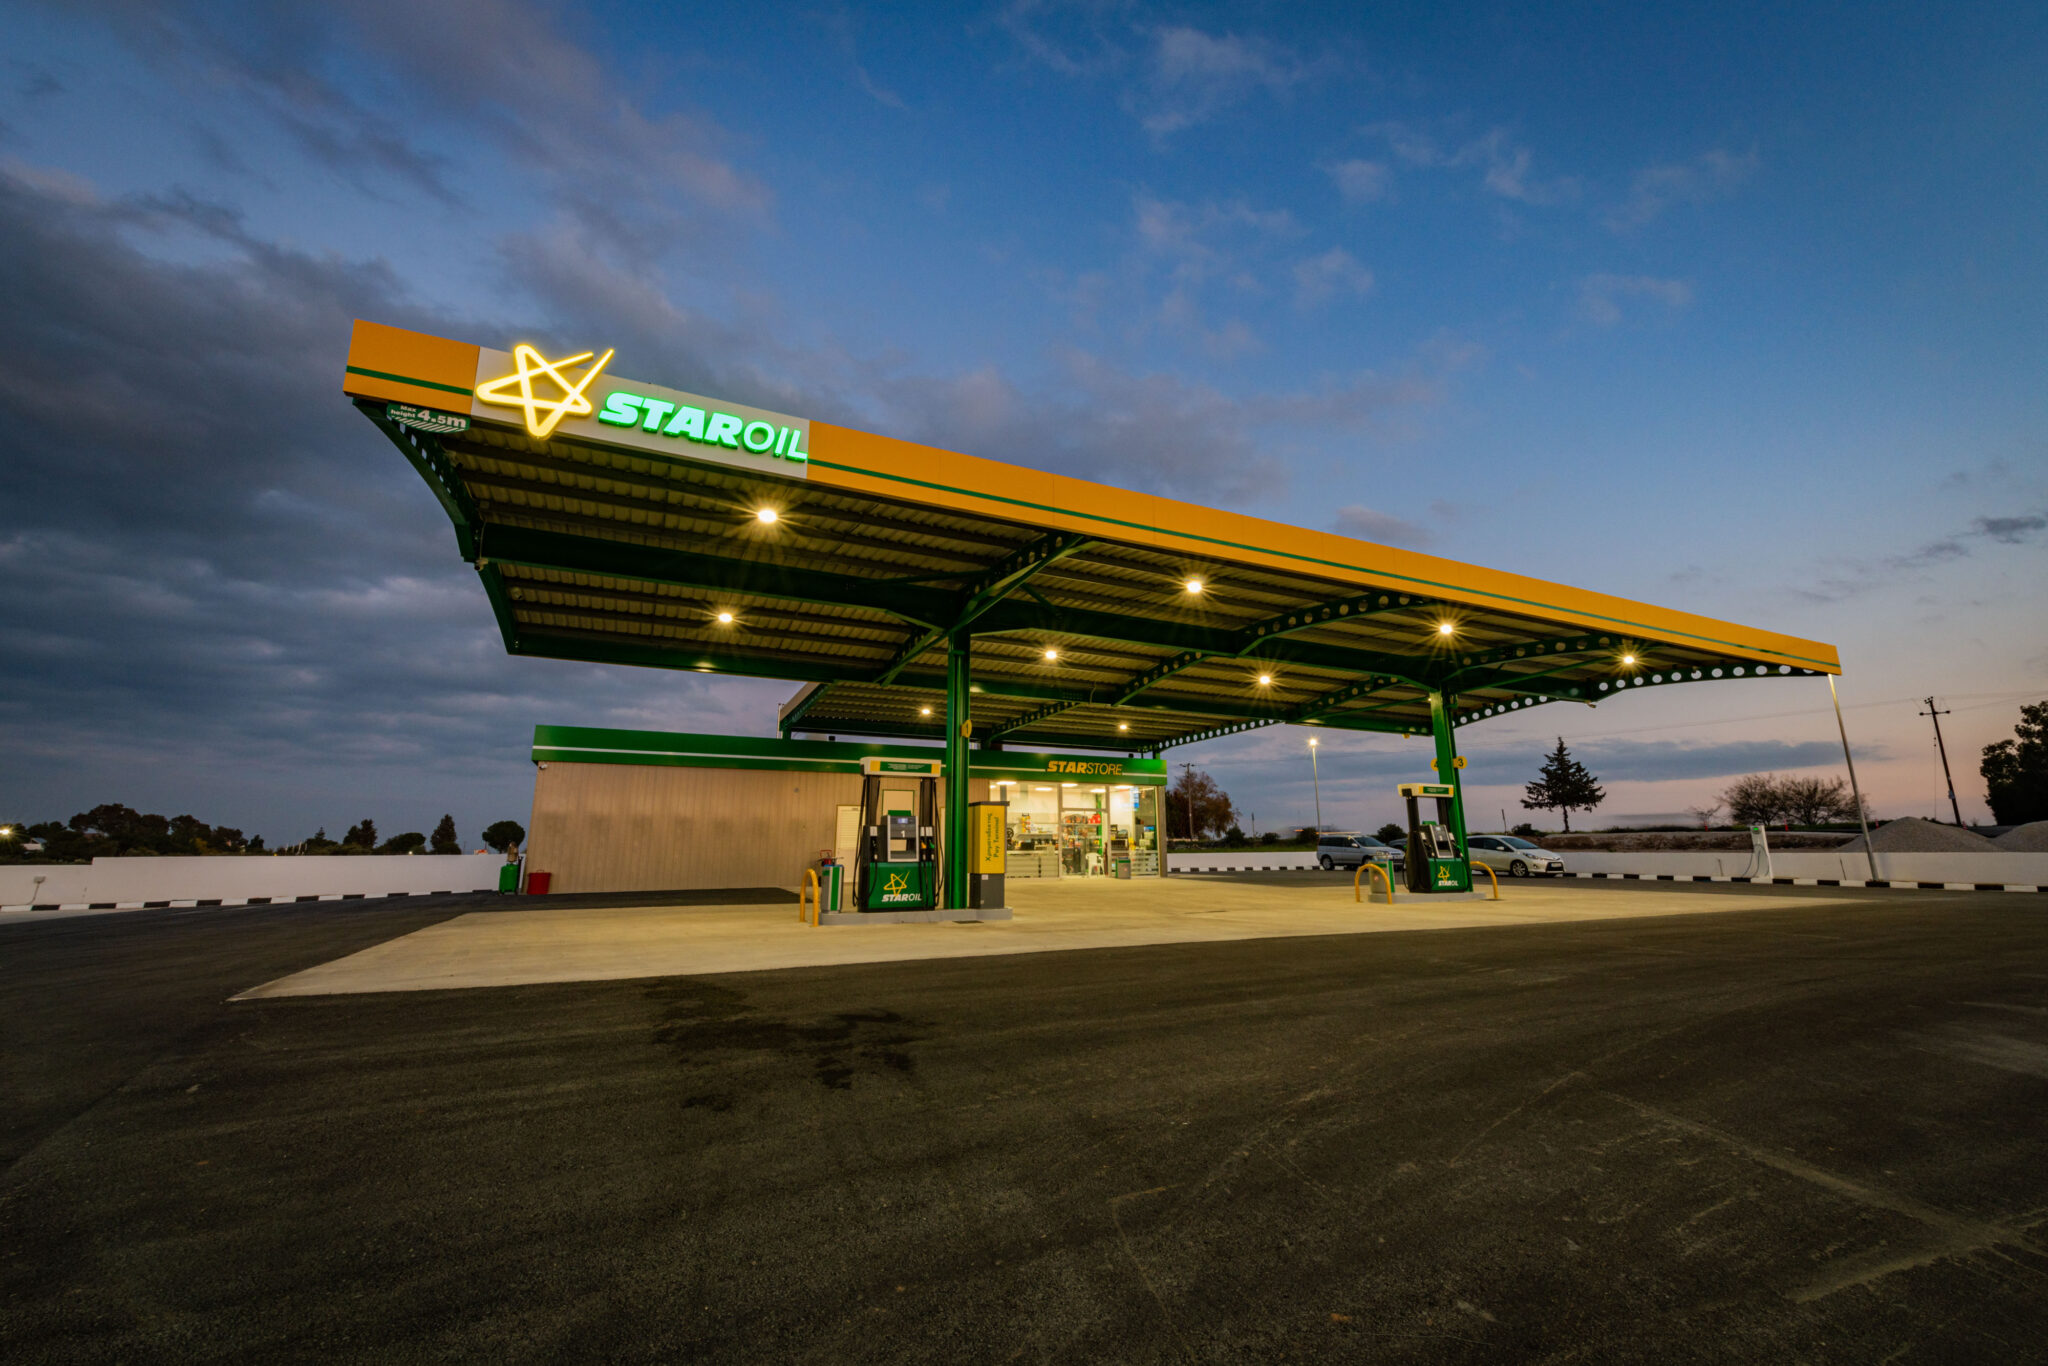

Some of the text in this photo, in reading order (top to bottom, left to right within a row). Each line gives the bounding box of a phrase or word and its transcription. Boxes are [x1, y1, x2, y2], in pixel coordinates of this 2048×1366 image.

[390, 409, 416, 418] height
[417, 409, 467, 428] 4.5m
[598, 391, 808, 462] STAROIL
[1458, 758, 1464, 767] 3
[1046, 760, 1123, 775] STARSTORE
[900, 830, 906, 838] 1
[881, 893, 922, 902] STAROIL
